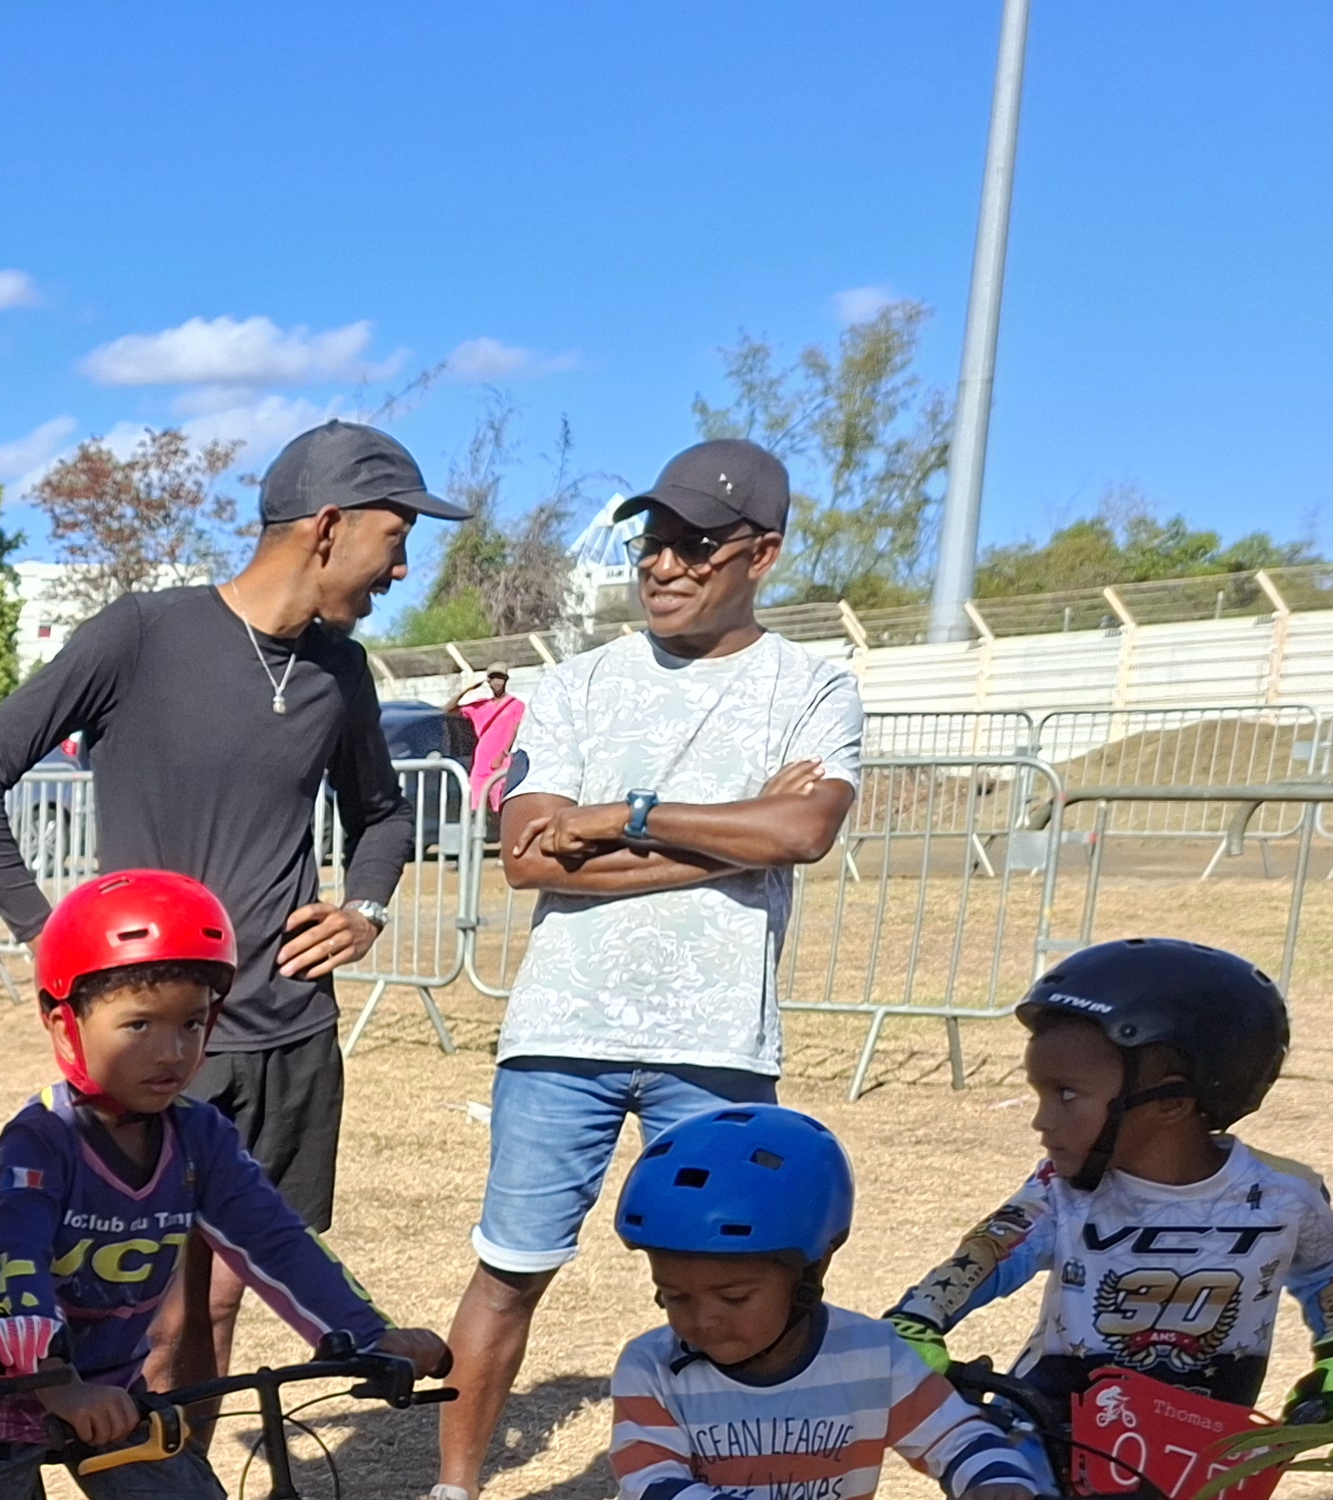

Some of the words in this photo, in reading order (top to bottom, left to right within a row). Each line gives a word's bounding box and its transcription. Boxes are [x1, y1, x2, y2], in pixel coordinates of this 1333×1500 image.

[1083, 1223, 1288, 1255] VCT
[1091, 1266, 1245, 1337] 30
[1149, 1331, 1177, 1344] ANS
[1153, 1398, 1225, 1433] Thomas
[692, 1417, 762, 1470] CEAN
[771, 1417, 854, 1462] LEAGUE
